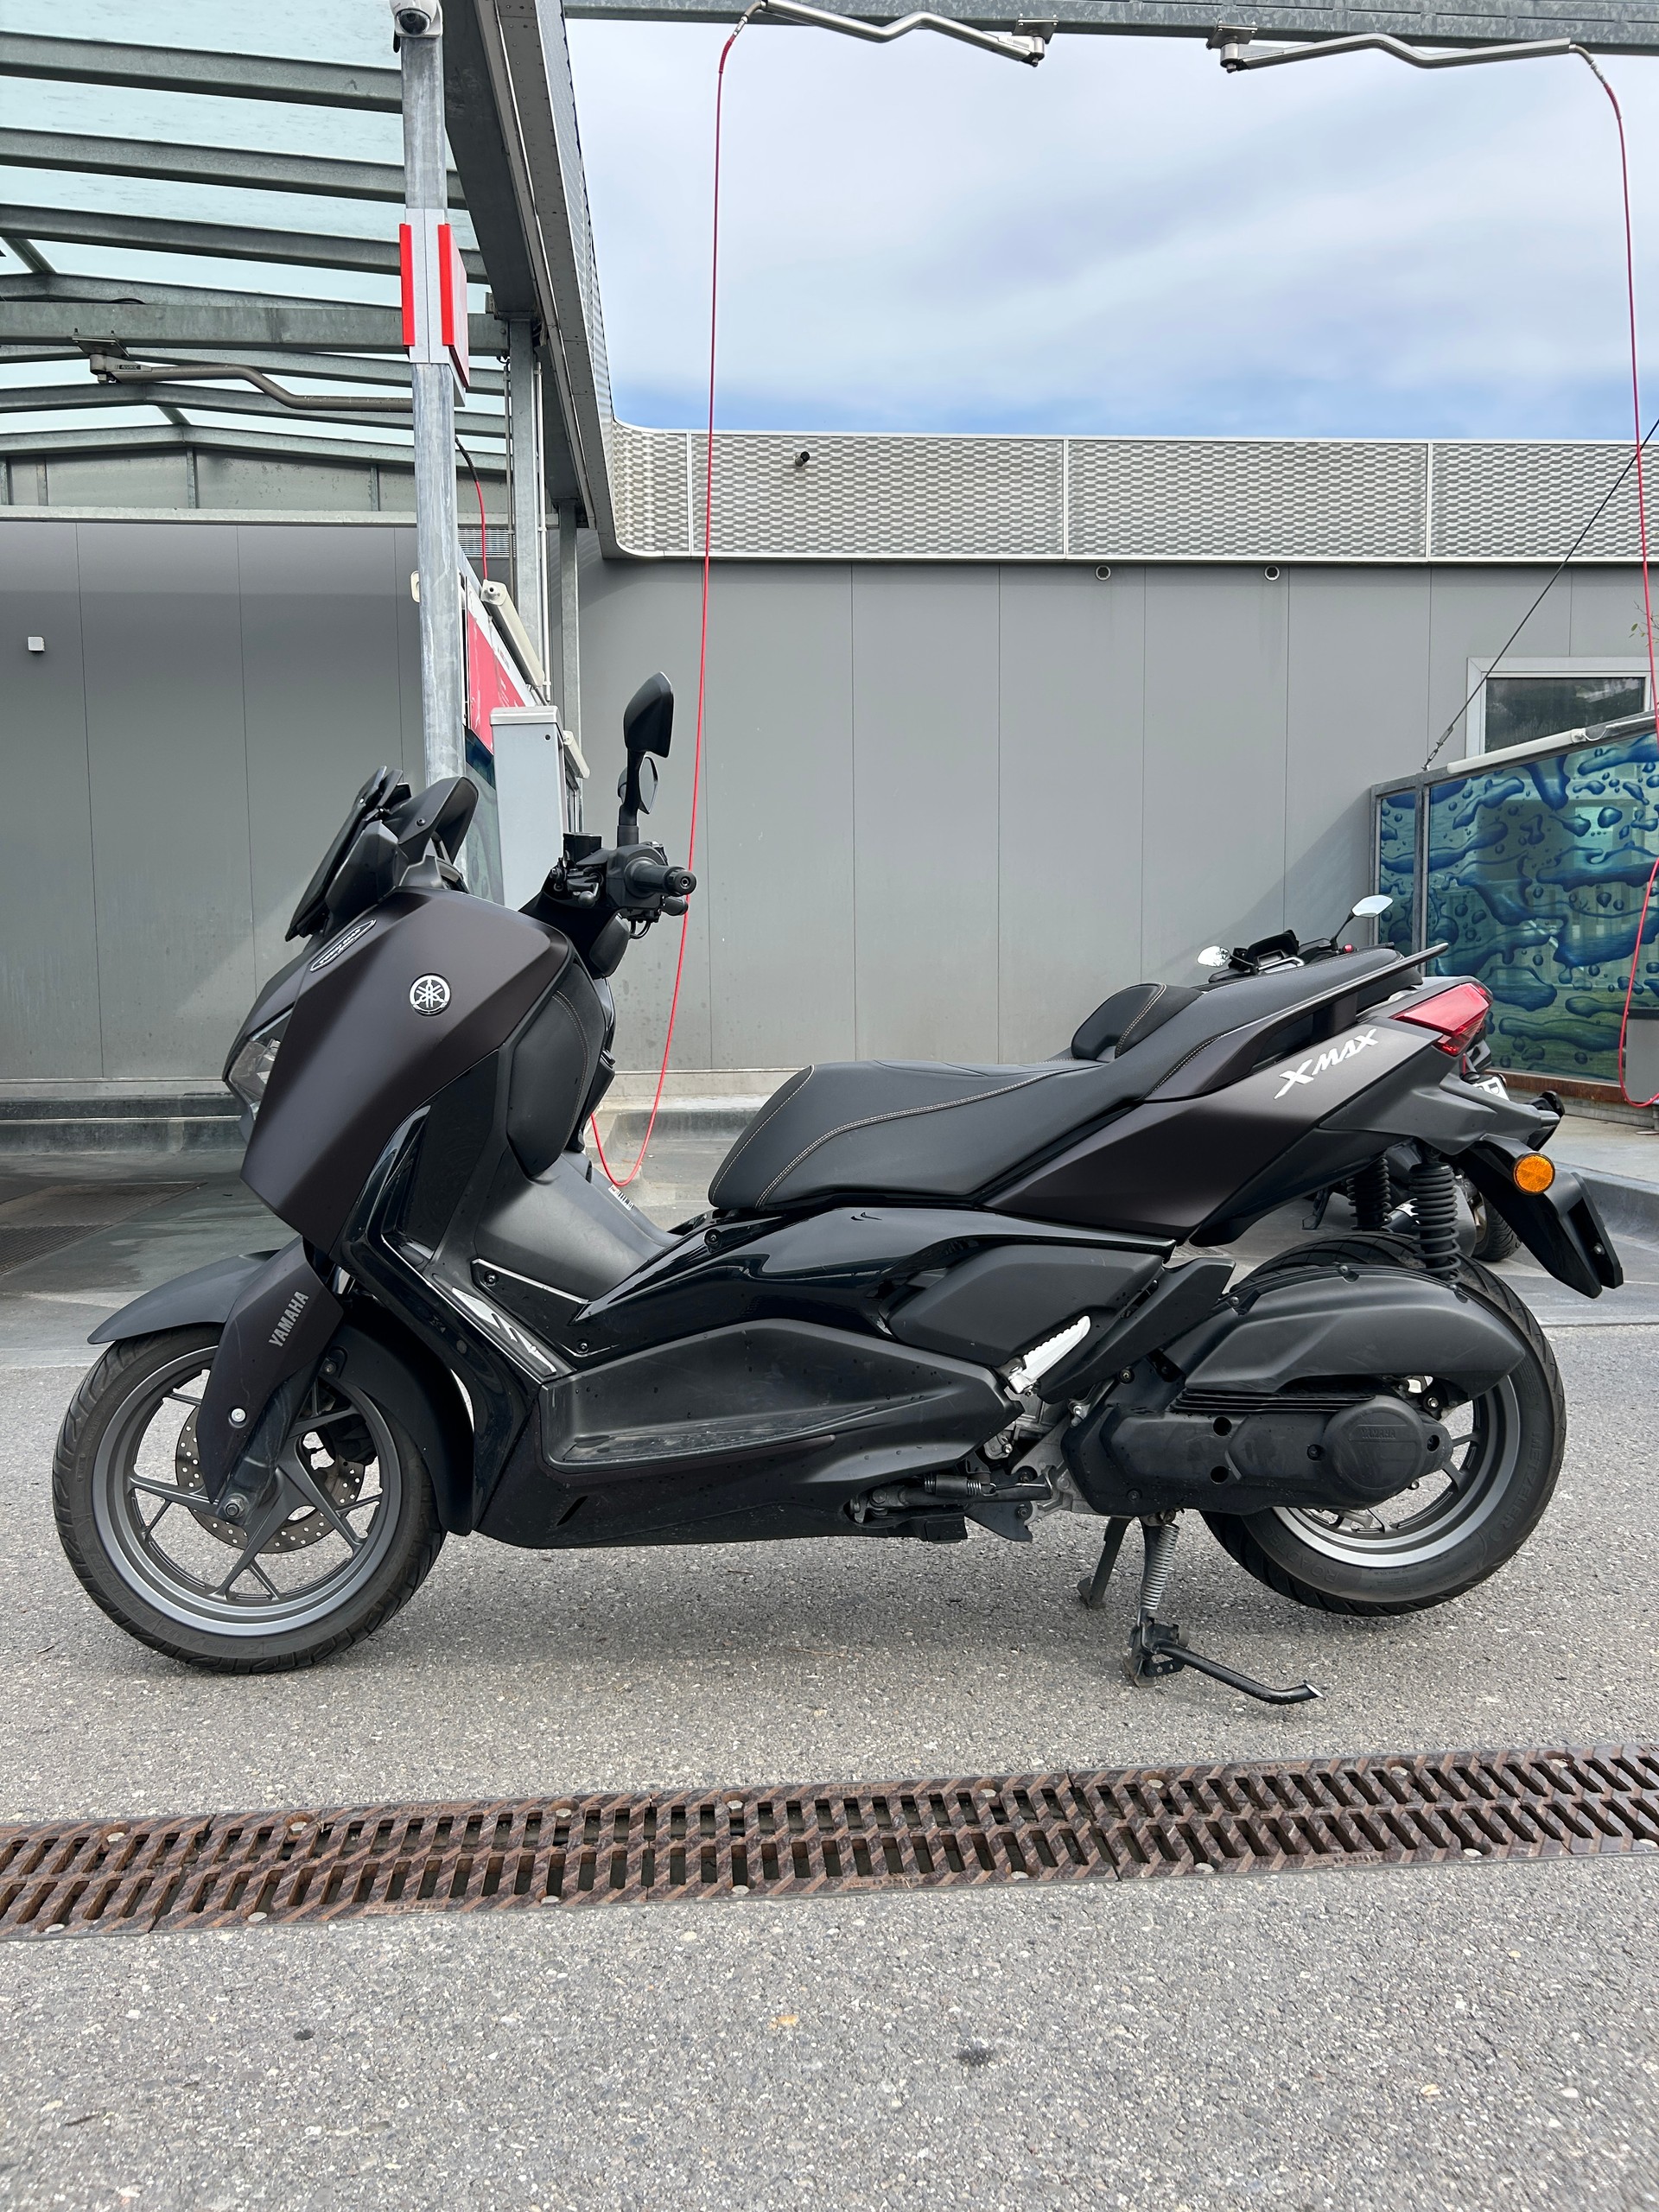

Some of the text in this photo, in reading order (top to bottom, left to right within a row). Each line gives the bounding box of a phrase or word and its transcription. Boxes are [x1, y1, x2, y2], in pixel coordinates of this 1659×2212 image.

[268, 1291, 309, 1347] YAMAHA
[1500, 1431, 1543, 1529] METZELER
[1262, 1526, 1339, 1584] ROADTEC
